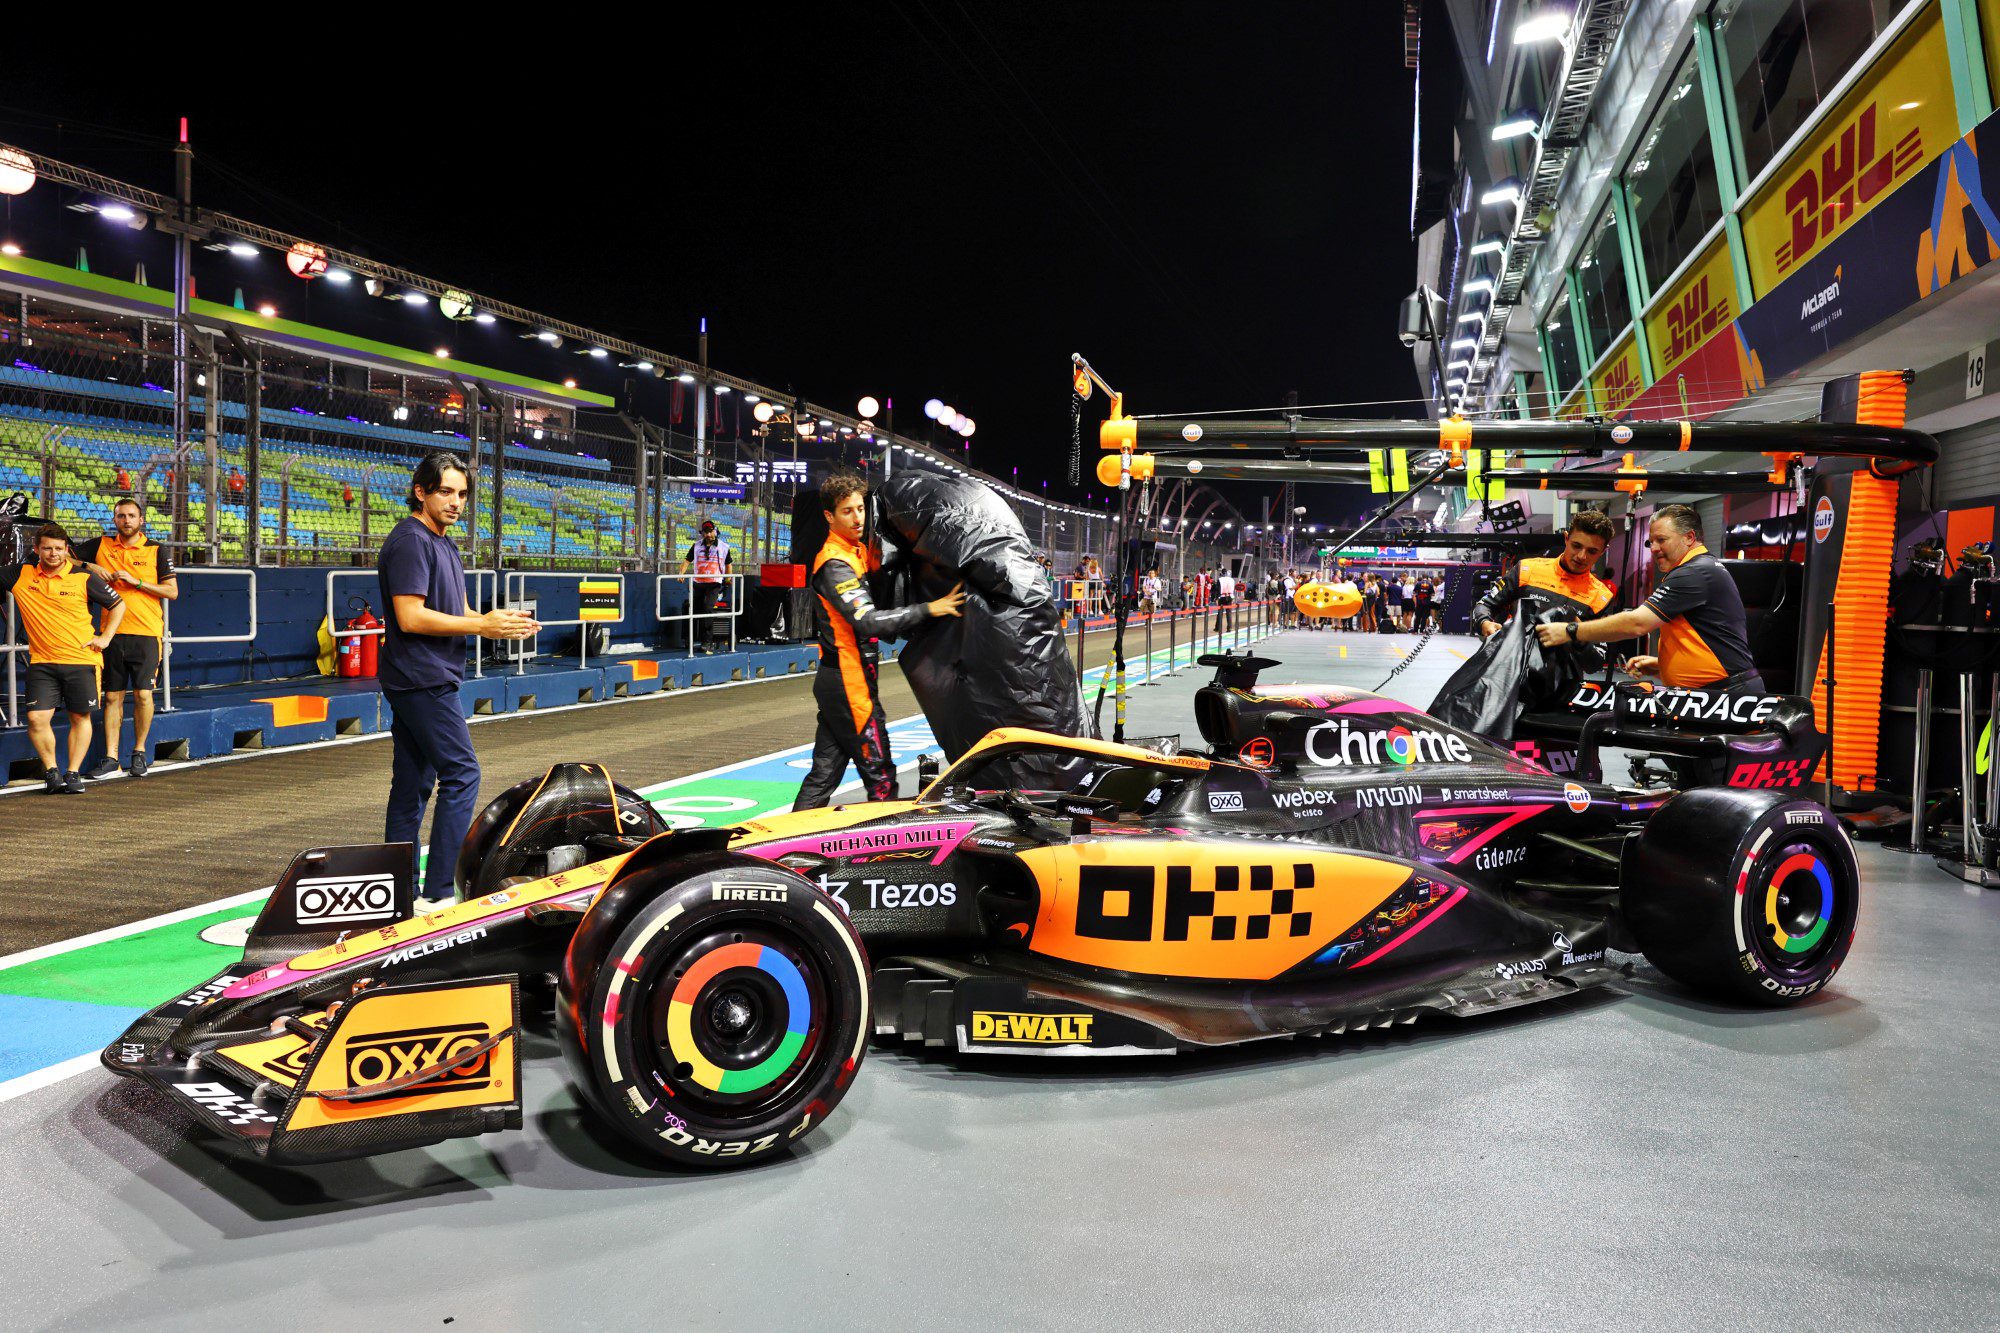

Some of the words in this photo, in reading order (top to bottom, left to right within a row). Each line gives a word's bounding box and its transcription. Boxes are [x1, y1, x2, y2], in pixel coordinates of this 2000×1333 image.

[1784, 101, 1895, 263] DHL
[1801, 282, 1840, 320] McLaren
[1666, 274, 1718, 361] DHL
[1604, 356, 1635, 411] DHL
[1968, 356, 1984, 389] 18
[1815, 514, 1832, 527] Gulf
[1304, 719, 1473, 767] Chrome
[1210, 793, 1243, 810] OXXO
[1272, 787, 1338, 809] webex
[1454, 786, 1509, 801] smartsheet
[1566, 792, 1589, 801] Gulf
[1067, 804, 1093, 816] Medallia
[1784, 810, 1824, 825] PIRELLI
[820, 833, 898, 854] RICHARD
[904, 827, 957, 844] MILLE
[976, 838, 1016, 849] vmware
[299, 880, 393, 919] OXXO
[712, 881, 788, 903] PIRELLI
[862, 878, 957, 909] Tezos
[380, 927, 488, 969] McLaren
[1510, 958, 1547, 975] KAUST
[1761, 977, 1821, 997] ZERO
[349, 1036, 488, 1091] OXXO
[788, 1112, 812, 1139] P
[658, 1126, 780, 1157] ZERO
